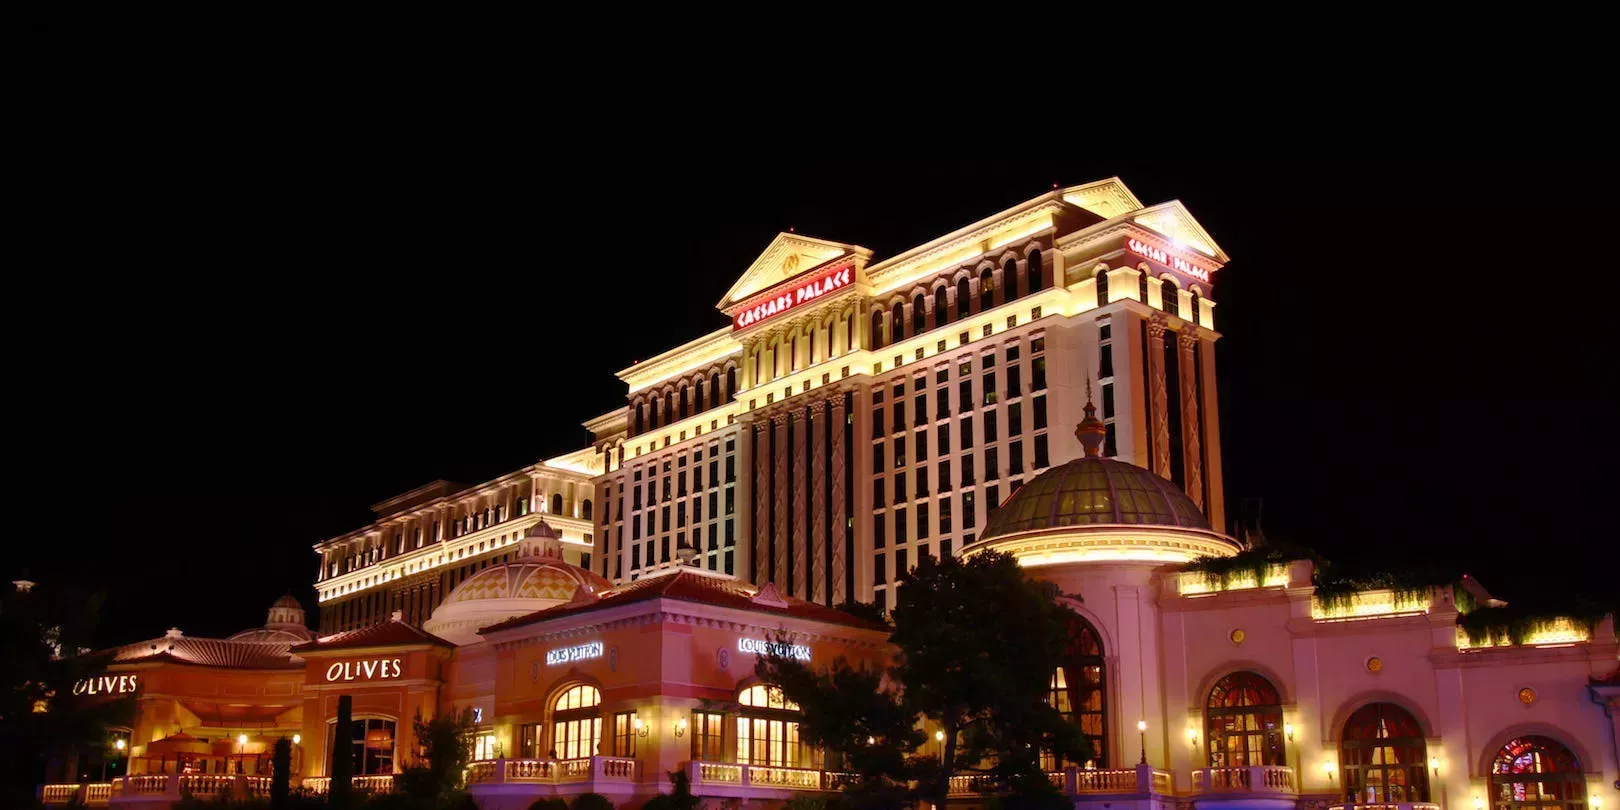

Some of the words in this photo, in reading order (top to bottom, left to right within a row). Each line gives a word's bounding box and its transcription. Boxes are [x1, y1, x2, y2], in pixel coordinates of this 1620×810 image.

[1174, 257, 1209, 282] PALACE
[737, 293, 792, 327] CAESARS
[796, 268, 850, 304] PALACE
[738, 637, 768, 655] LOUIS
